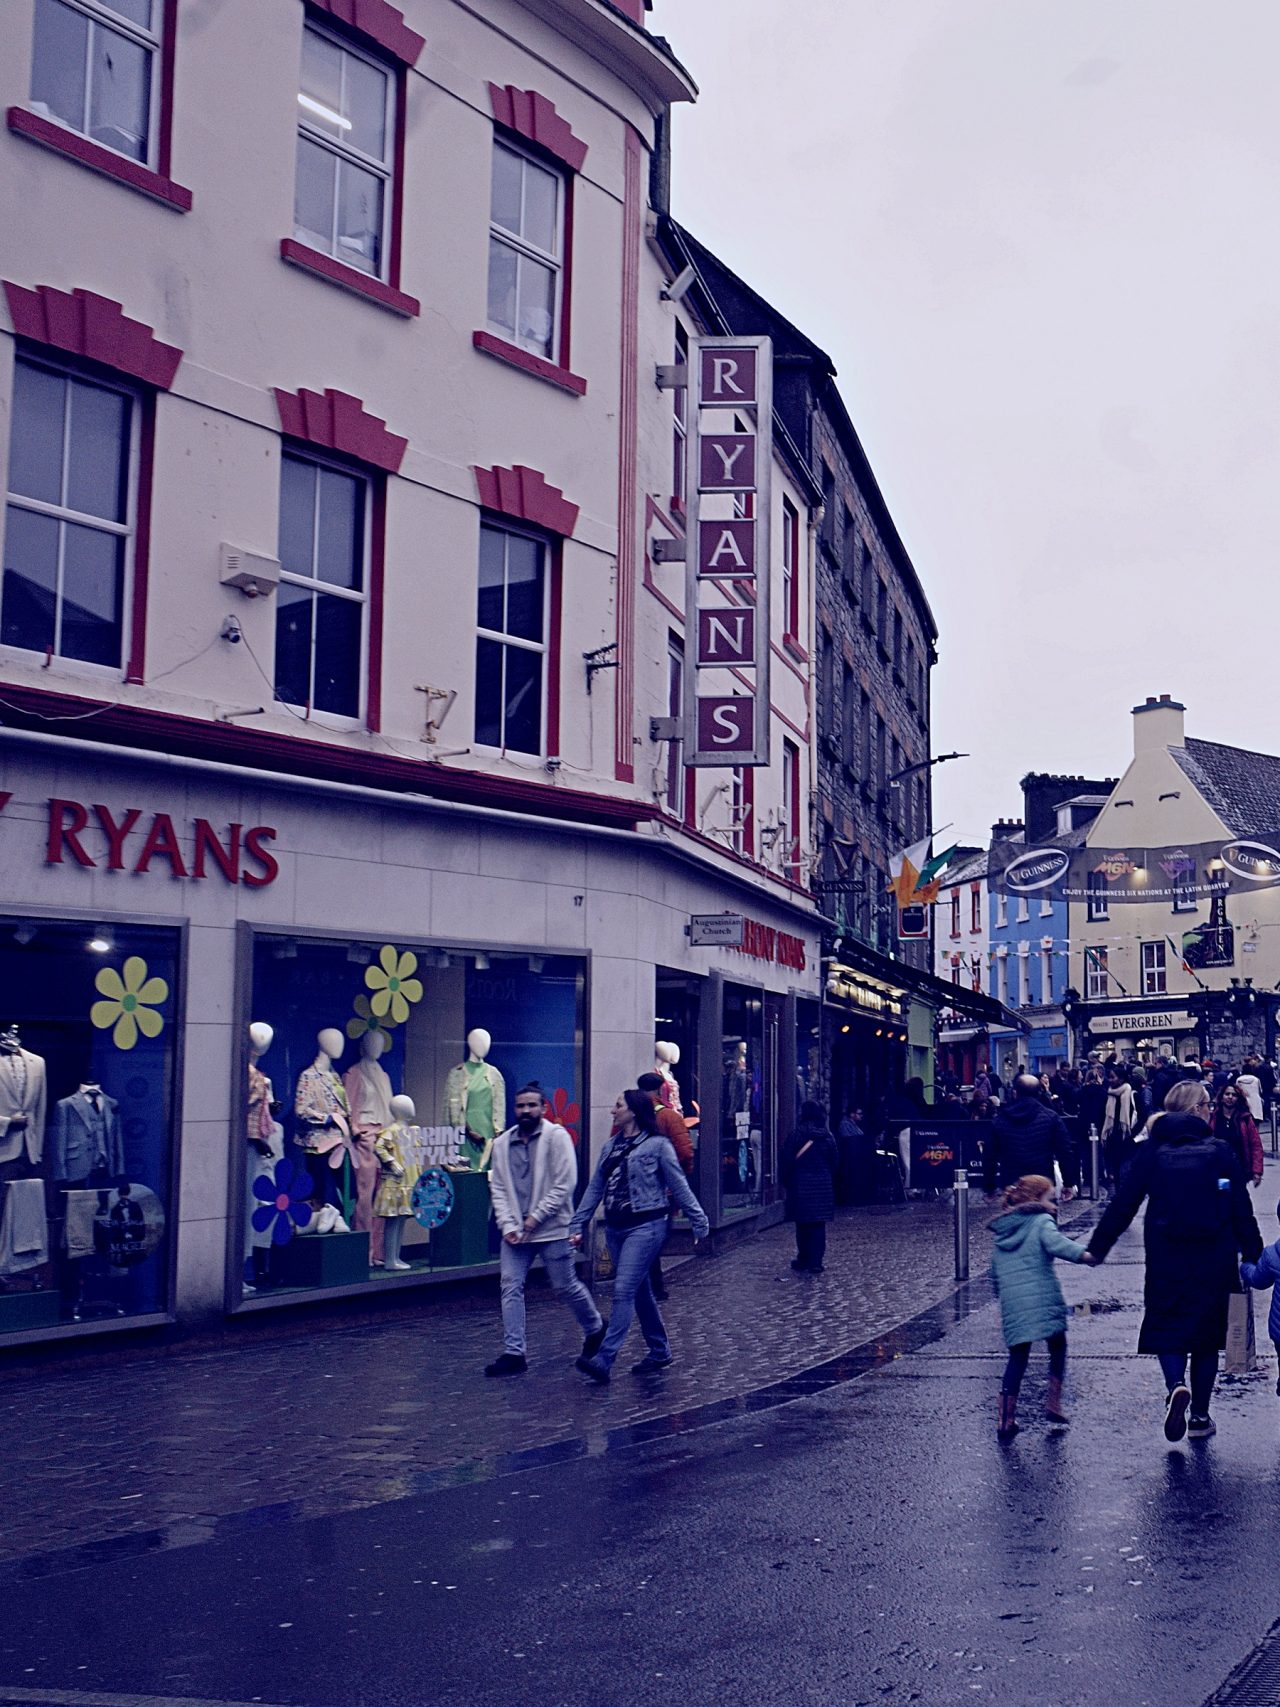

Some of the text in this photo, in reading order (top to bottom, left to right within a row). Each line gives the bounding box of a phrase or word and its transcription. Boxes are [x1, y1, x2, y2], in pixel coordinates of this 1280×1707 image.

[708, 358, 746, 744] RYANS
[46, 798, 280, 887] RYANS
[1020, 856, 1064, 880] GUINNESS
[822, 883, 863, 891] GUINNESS
[1138, 888, 1163, 896] NATIONS
[1185, 885, 1202, 893] LATIN
[1203, 881, 1230, 891] QUARTER
[694, 918, 741, 928] Augustinian
[703, 927, 732, 936] Church
[1112, 1014, 1173, 1030] EVERGREEN
[395, 1125, 466, 1147] SPRING
[402, 1145, 460, 1166] STYLE
